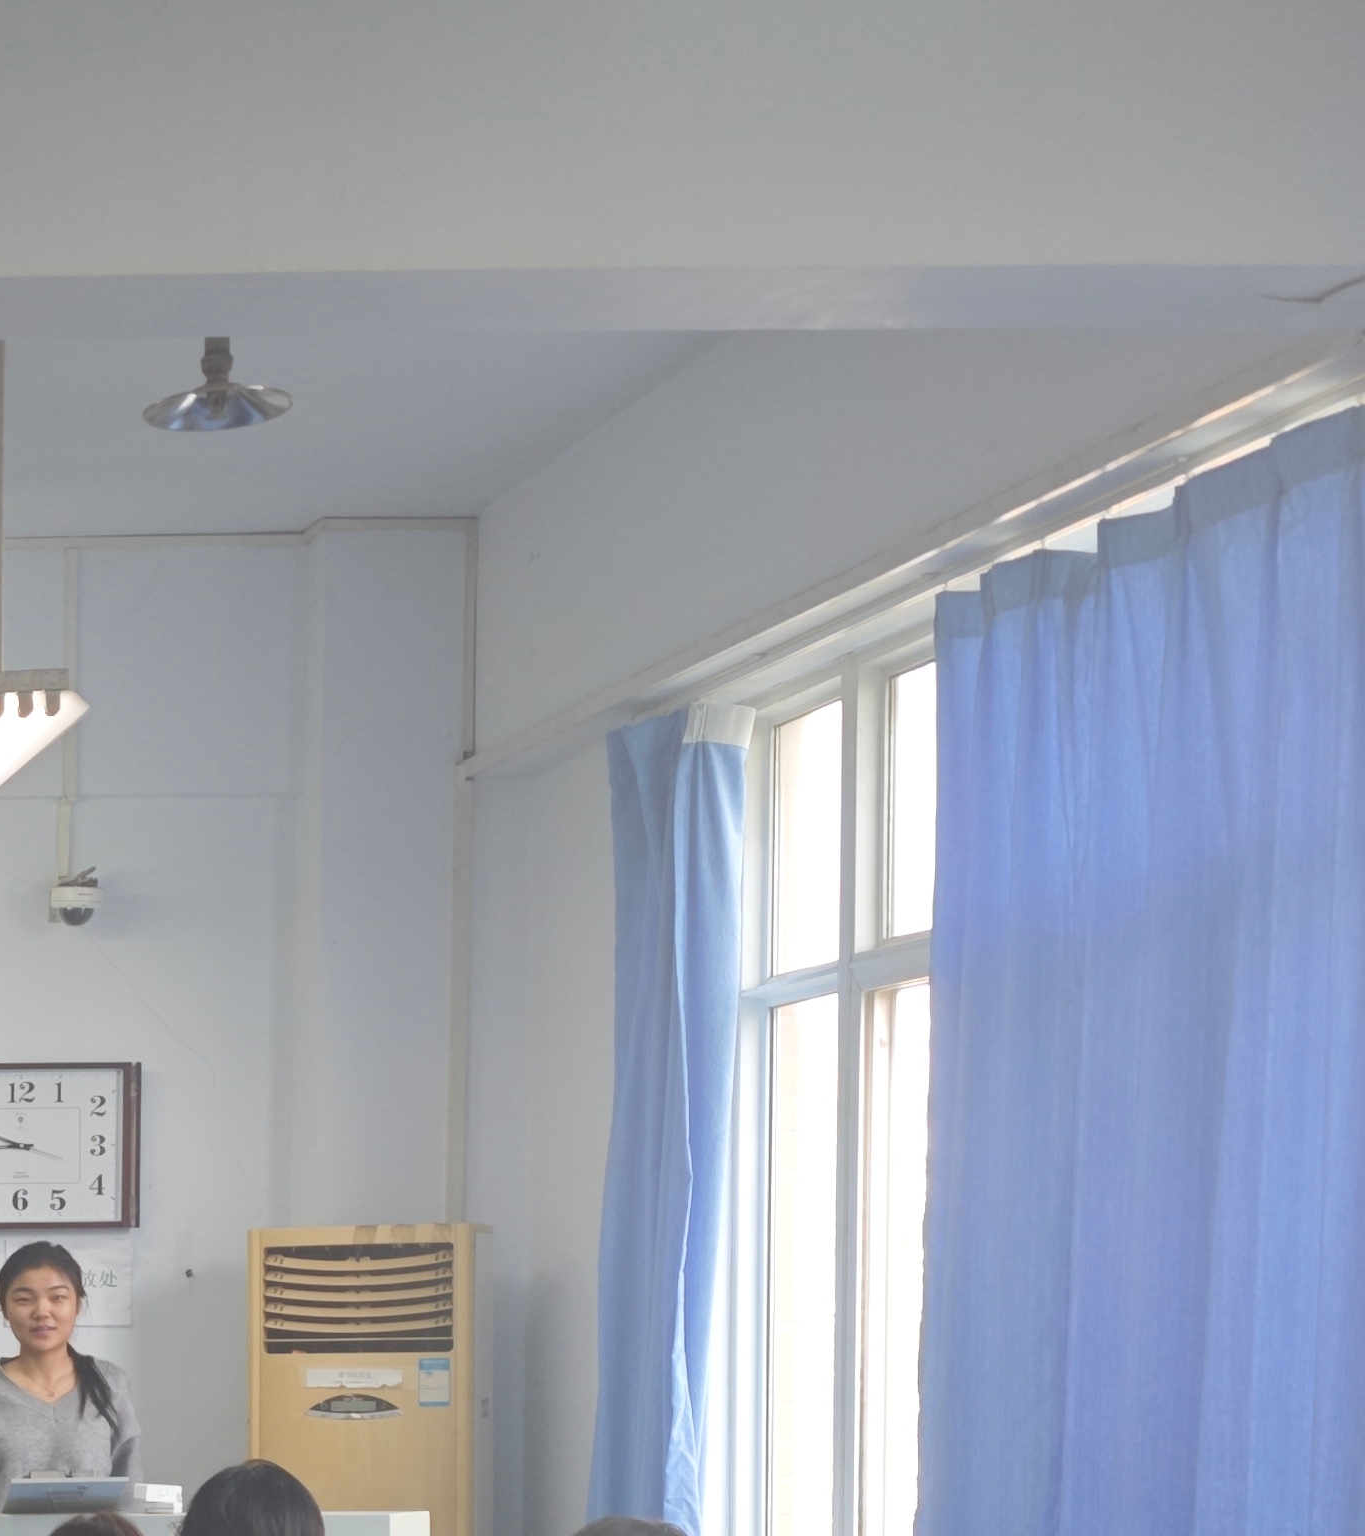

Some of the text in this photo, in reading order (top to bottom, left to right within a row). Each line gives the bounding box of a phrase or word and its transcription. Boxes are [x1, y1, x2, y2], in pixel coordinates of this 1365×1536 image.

[7, 1081, 36, 1104] 12
[54, 1081, 65, 1103] 1
[89, 1095, 107, 1117] 2
[89, 1134, 107, 1156] 3
[88, 1174, 106, 1196] 4
[11, 1188, 29, 1211] 6
[49, 1189, 66, 1211] 5
